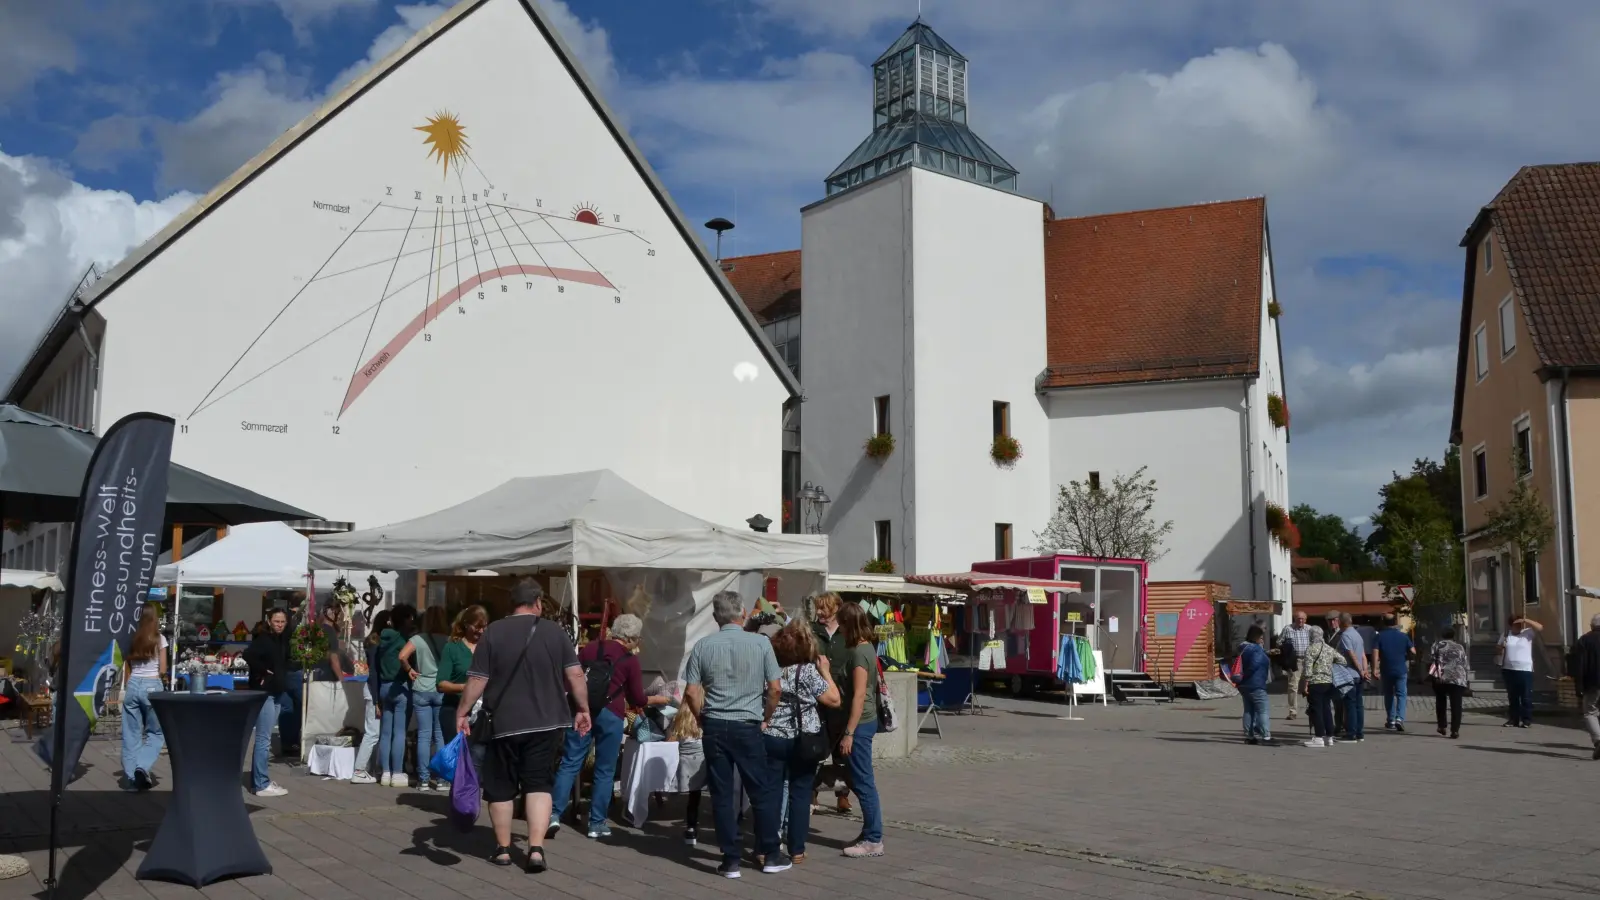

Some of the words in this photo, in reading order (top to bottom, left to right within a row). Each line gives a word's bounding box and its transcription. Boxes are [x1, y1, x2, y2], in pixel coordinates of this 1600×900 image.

[386, 186, 393, 196] X
[646, 248, 656, 257] 20
[500, 284, 508, 293] 16
[525, 281, 534, 291] 17
[557, 285, 565, 294] 18
[477, 291, 485, 301] 15
[613, 295, 621, 304] 19
[458, 306, 466, 315] 14
[423, 333, 432, 343] 13
[180, 424, 189, 434] 11
[240, 420, 289, 434] Sommerzeit
[331, 425, 341, 435] 12
[108, 467, 138, 634] Gesundheits-
